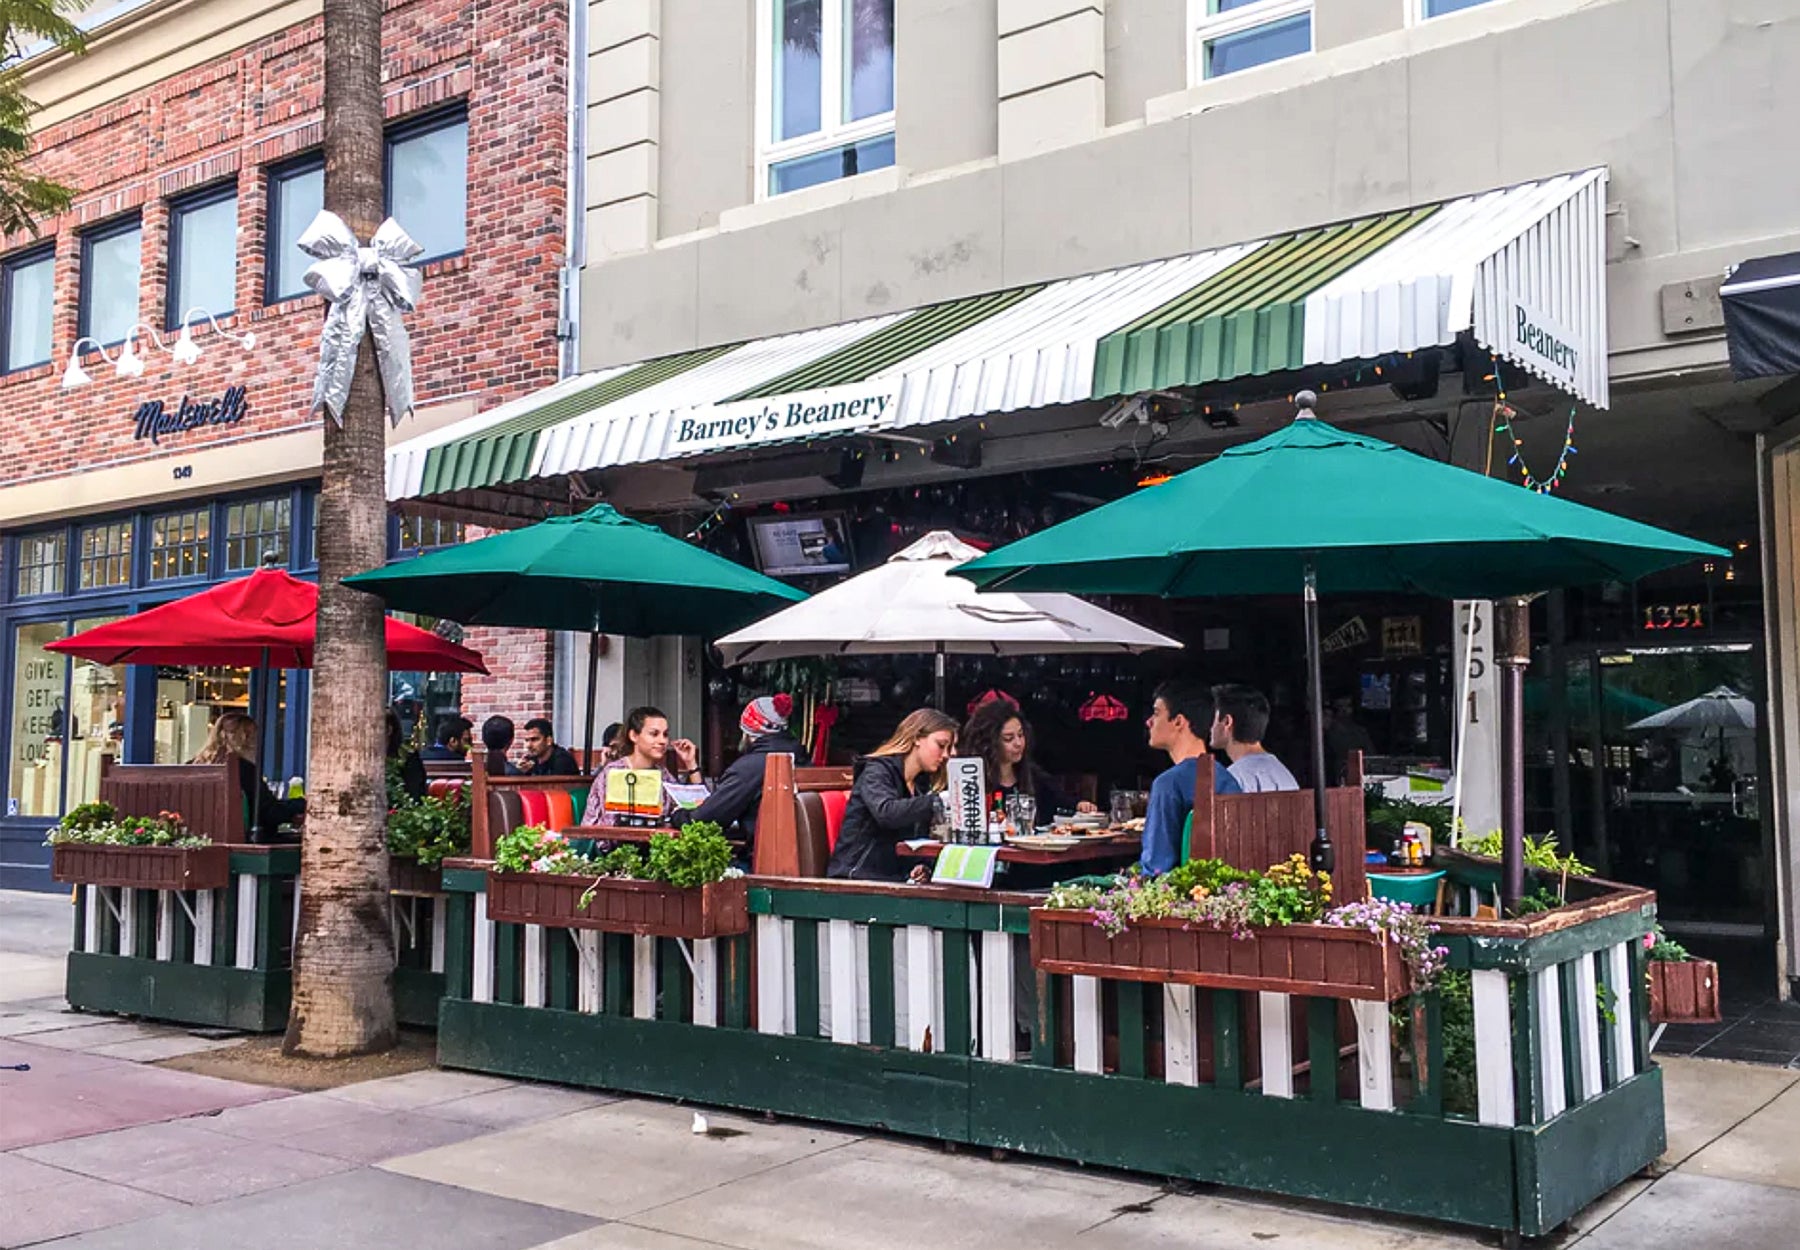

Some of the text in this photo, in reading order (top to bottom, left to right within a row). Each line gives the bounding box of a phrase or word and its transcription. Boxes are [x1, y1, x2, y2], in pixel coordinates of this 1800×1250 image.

[1515, 304, 1578, 383] Beanery
[132, 384, 248, 445] Madewell
[676, 394, 892, 443] Barney's Beanery
[1644, 603, 1704, 630] 1351
[24, 661, 58, 680] GIVE.
[26, 689, 54, 708] GET.
